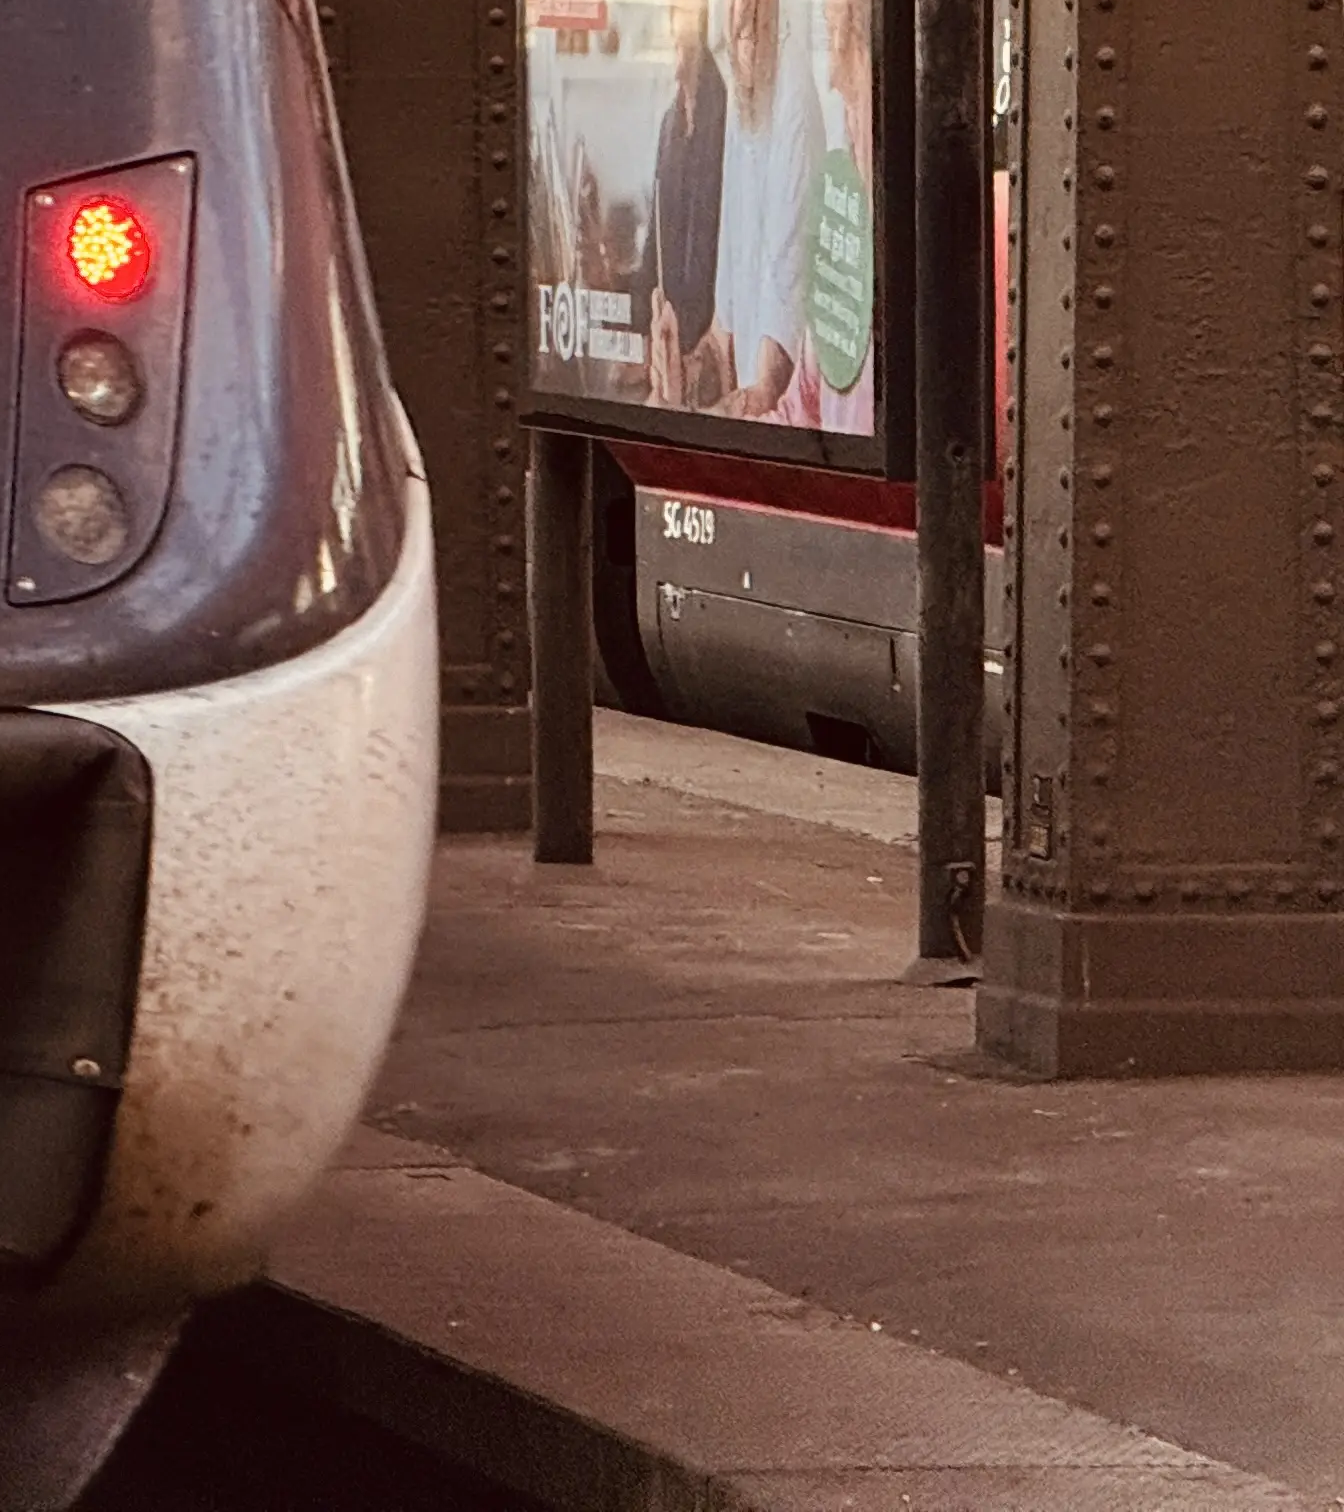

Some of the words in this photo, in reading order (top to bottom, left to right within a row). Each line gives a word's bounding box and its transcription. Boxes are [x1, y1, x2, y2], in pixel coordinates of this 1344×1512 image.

[538, 281, 590, 361] FOF
[663, 501, 682, 539] SG
[683, 505, 715, 545] 4519
